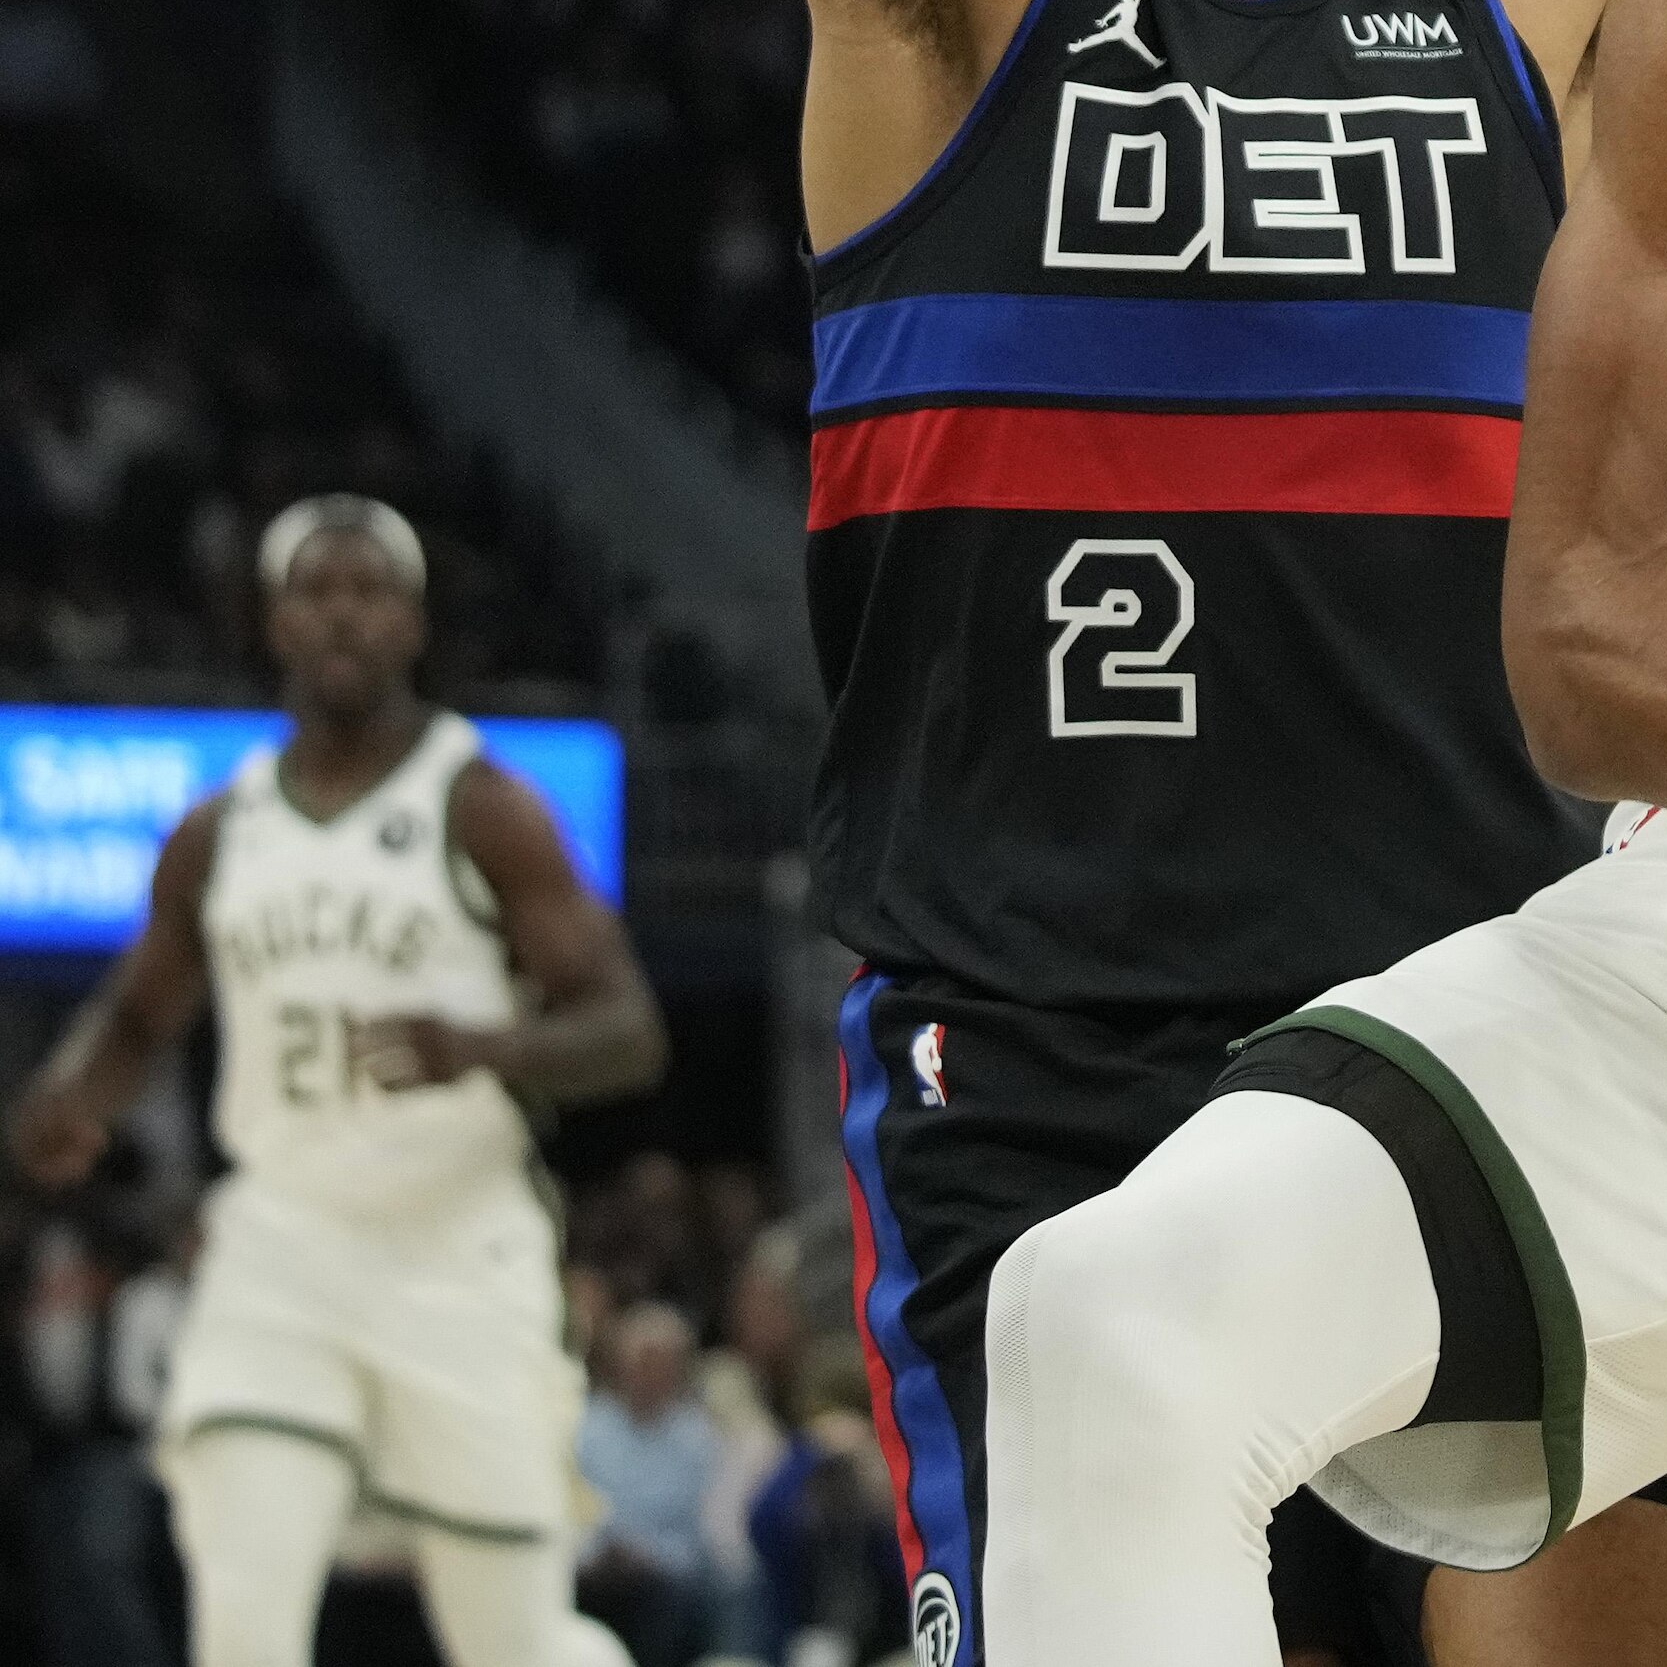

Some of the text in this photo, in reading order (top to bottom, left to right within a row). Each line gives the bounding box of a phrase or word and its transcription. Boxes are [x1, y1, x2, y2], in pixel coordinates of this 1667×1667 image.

[1340, 12, 1459, 47] UWM
[1043, 80, 1488, 274] DET
[1047, 538, 1198, 738] 2
